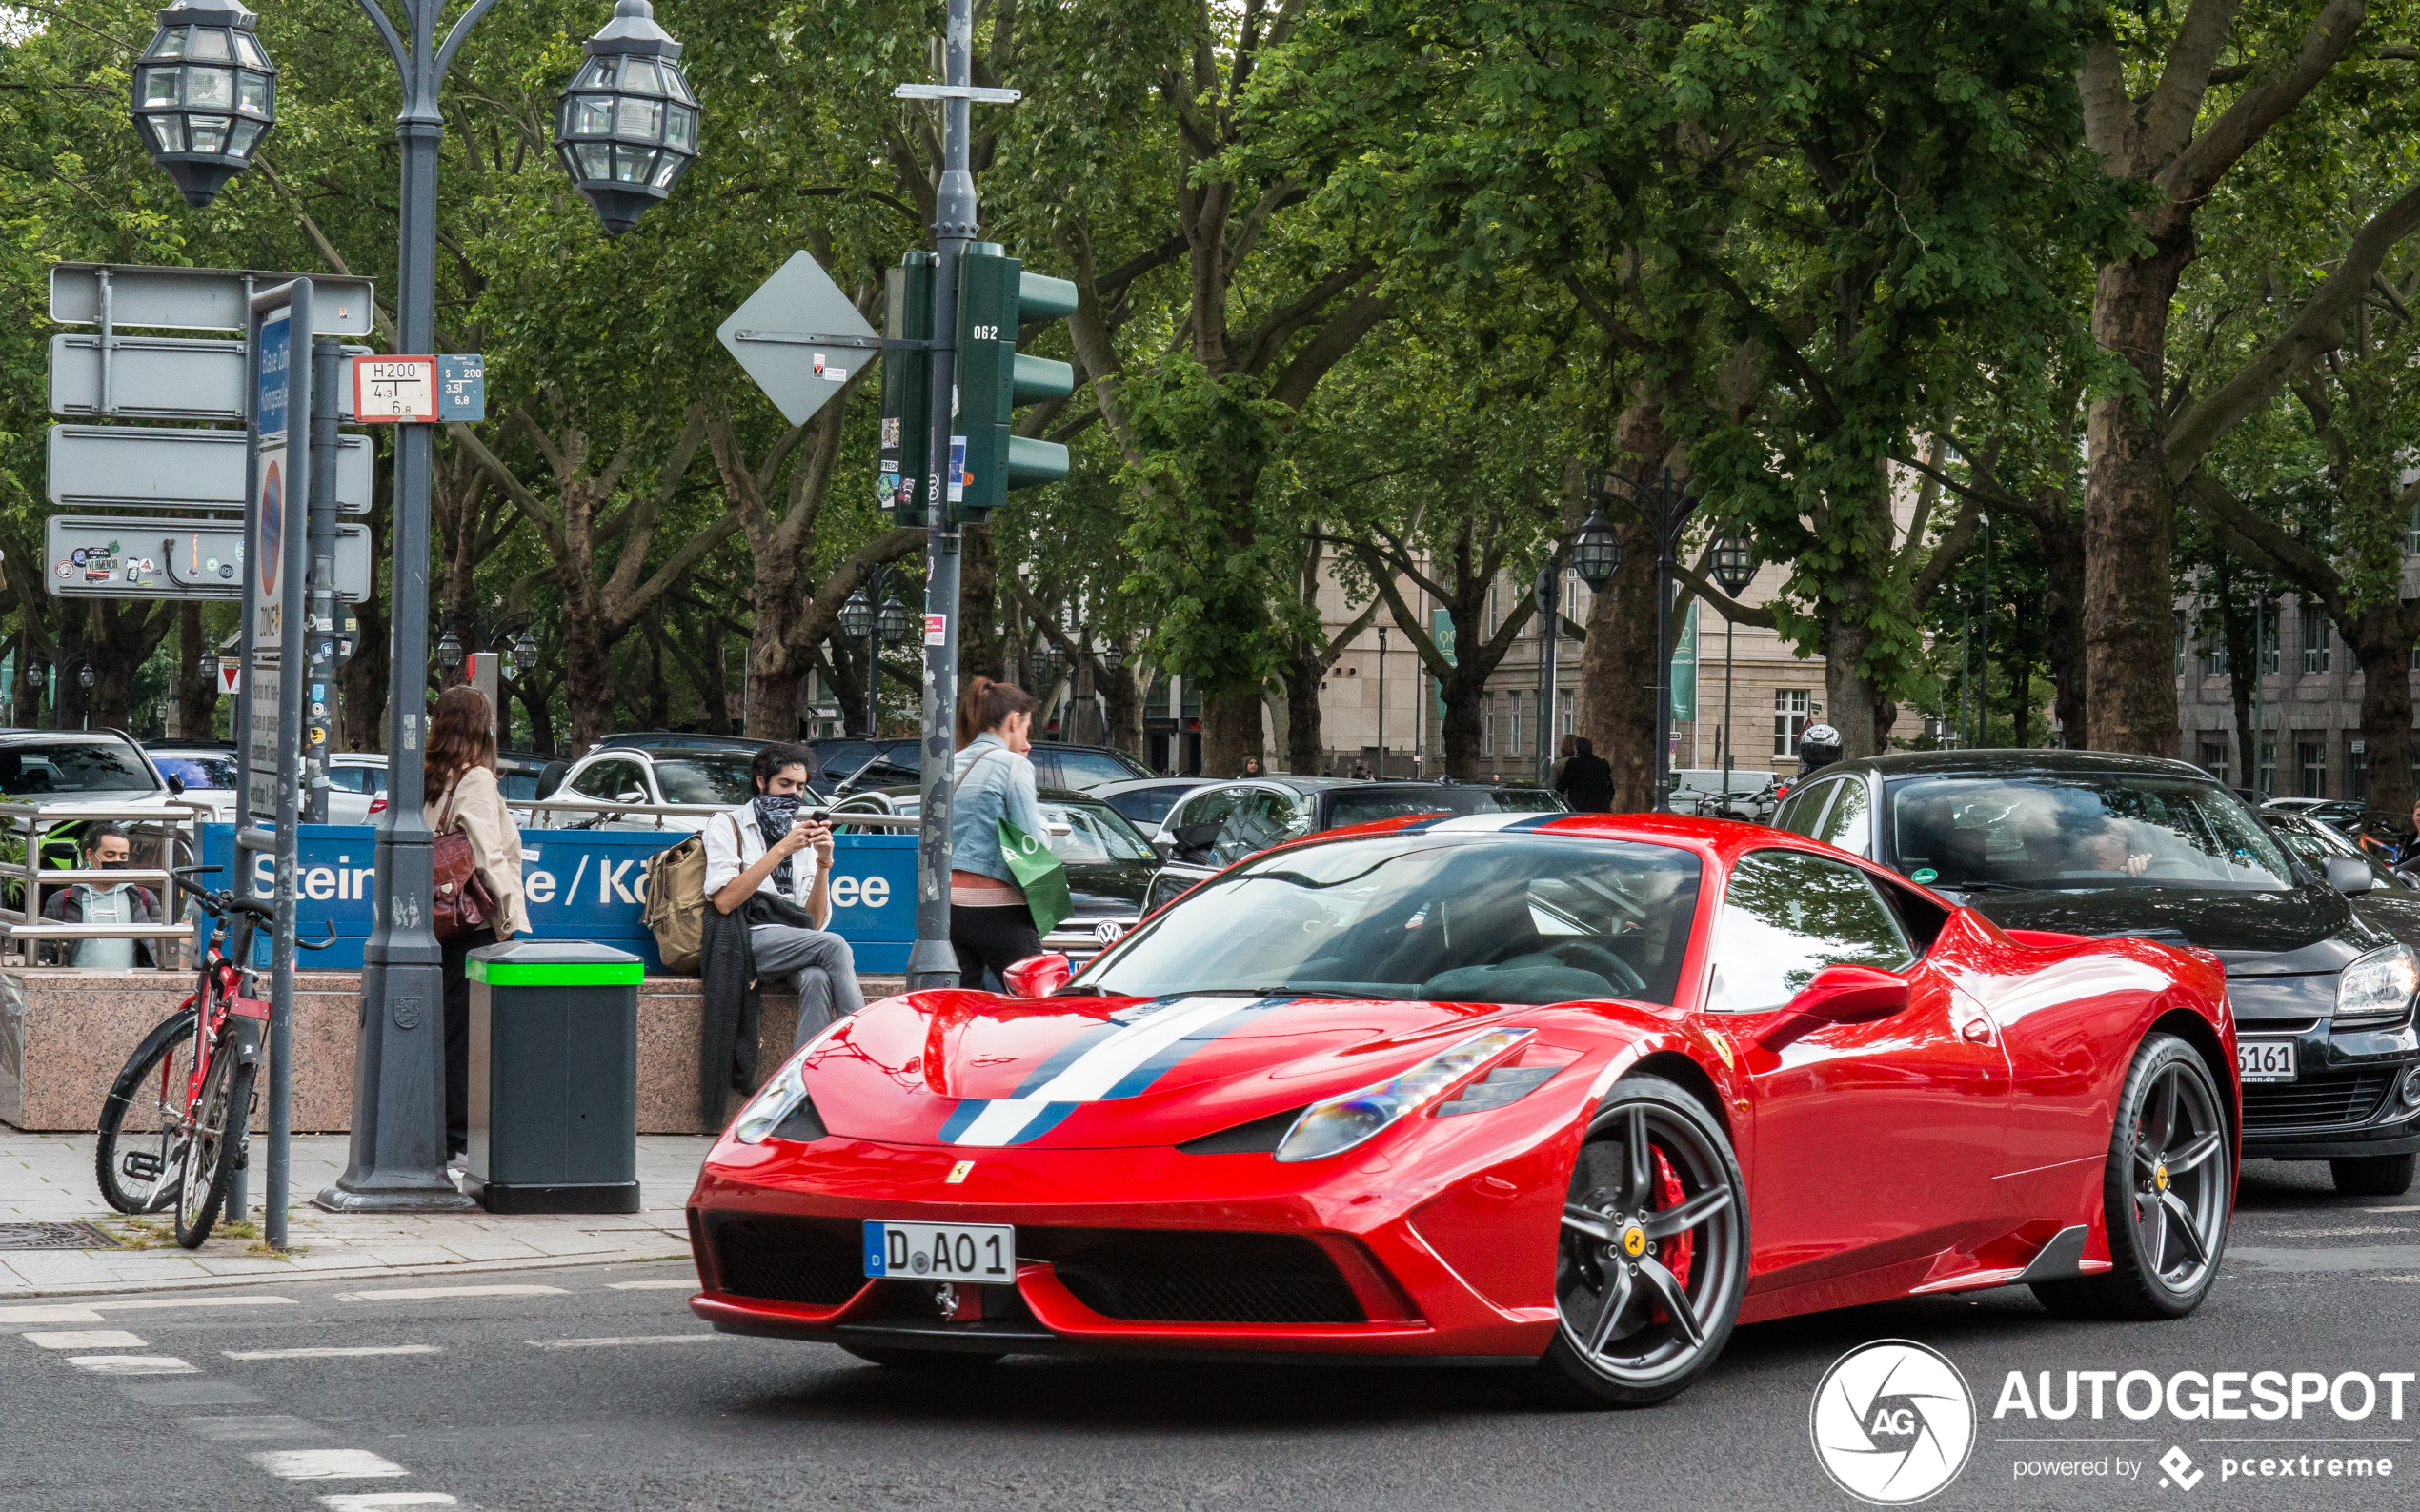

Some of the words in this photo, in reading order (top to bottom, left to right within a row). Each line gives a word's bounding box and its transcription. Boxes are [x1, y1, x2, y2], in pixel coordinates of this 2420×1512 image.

[974, 325, 998, 339] 062
[373, 363, 416, 378] H200
[445, 369, 451, 378] S
[463, 369, 482, 378] 200
[373, 385, 393, 398] 4.3
[445, 384, 459, 393] 3.5
[454, 395, 470, 405] 6.8
[393, 401, 411, 414] 6.8
[259, 606, 275, 637] ZONE
[253, 854, 375, 900] Sein
[871, 1254, 881, 1267] D
[886, 1229, 909, 1270] D
[985, 1234, 1007, 1275] 1
